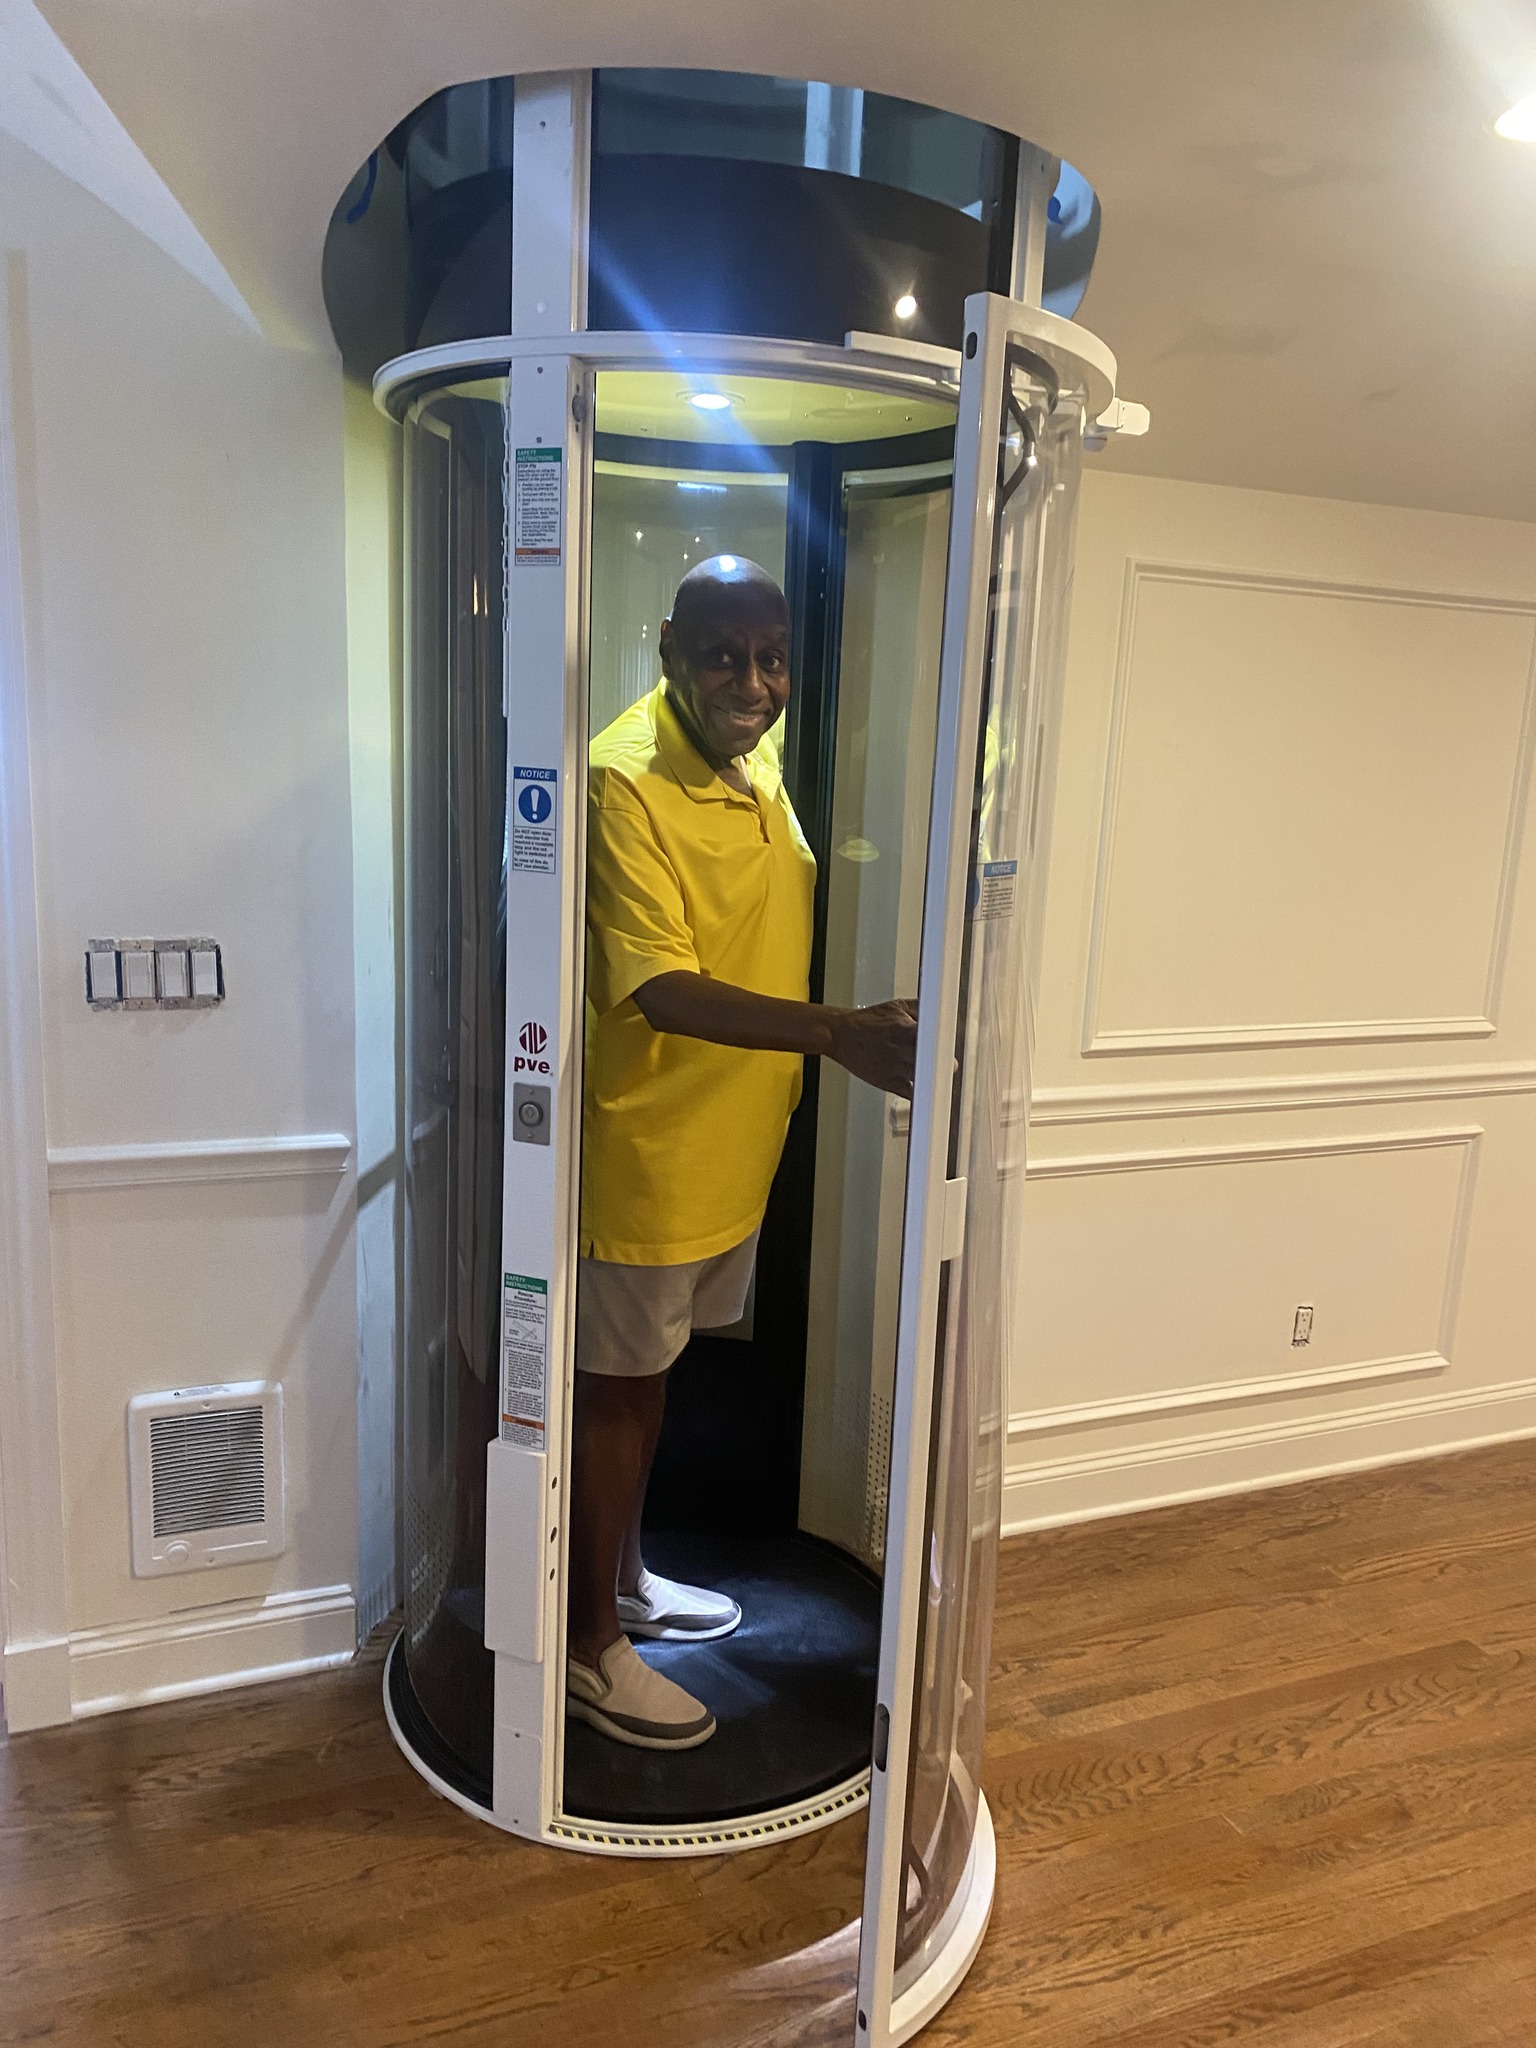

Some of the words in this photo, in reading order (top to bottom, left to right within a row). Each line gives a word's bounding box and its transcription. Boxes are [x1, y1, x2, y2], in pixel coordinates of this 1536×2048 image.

[520, 769, 551, 779] NOTICE
[991, 864, 1012, 873] NOTICE
[506, 1281, 543, 1292] INSTRUCTIONS
